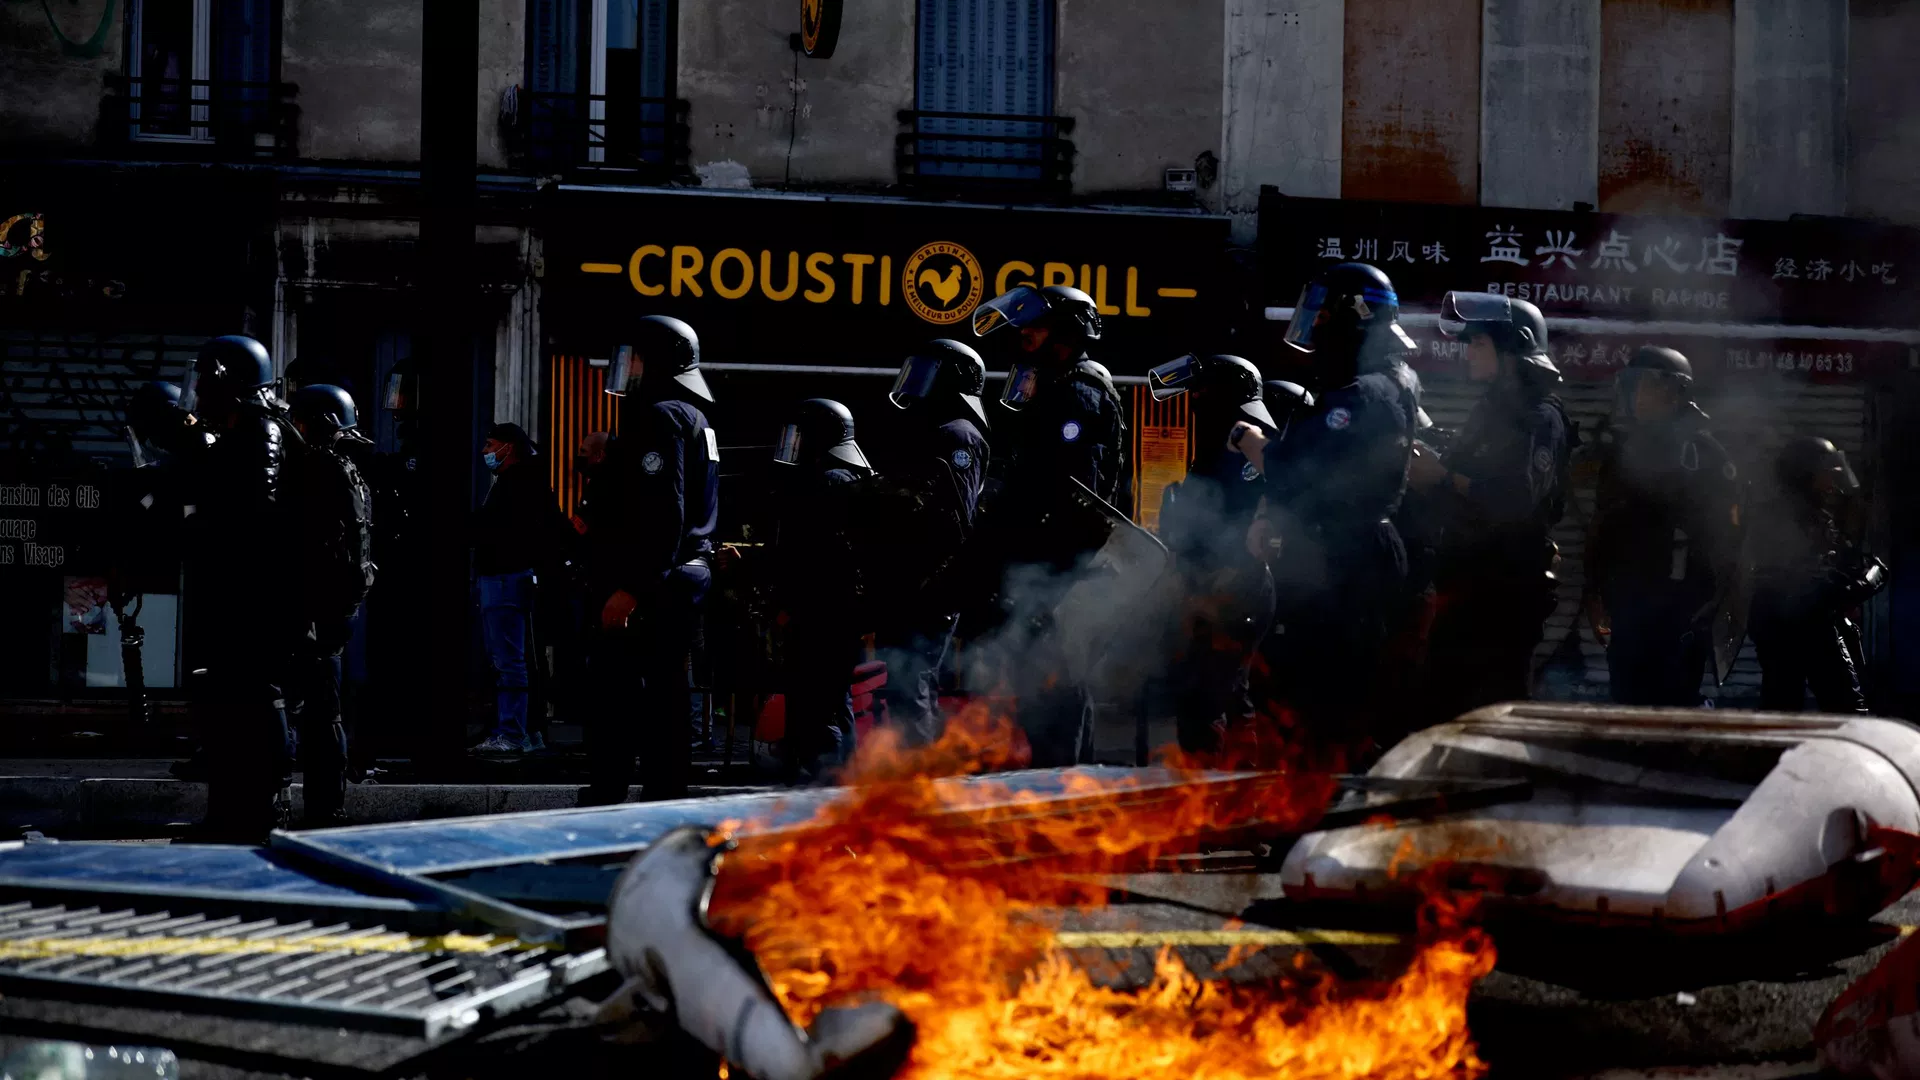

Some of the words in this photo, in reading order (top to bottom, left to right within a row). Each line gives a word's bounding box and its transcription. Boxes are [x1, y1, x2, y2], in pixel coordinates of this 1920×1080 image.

[917, 245, 971, 265] ORIGINAL
[1316, 237, 1450, 265] 温州风味
[1480, 223, 1744, 277] 益兴点心店
[629, 244, 892, 306] CROUSTI
[1772, 256, 1898, 285] 经济小吃
[907, 279, 914, 290] LE
[1487, 282, 1633, 304] RESTAURANT
[1652, 287, 1732, 309] RAPIDE
[909, 291, 942, 320] MEILLEUR
[957, 286, 979, 315] POULET
[944, 312, 956, 320] DU
[0, 483, 40, 507] ension
[48, 484, 70, 508] des
[76, 484, 100, 509] Cils
[24, 542, 64, 568] Visage
